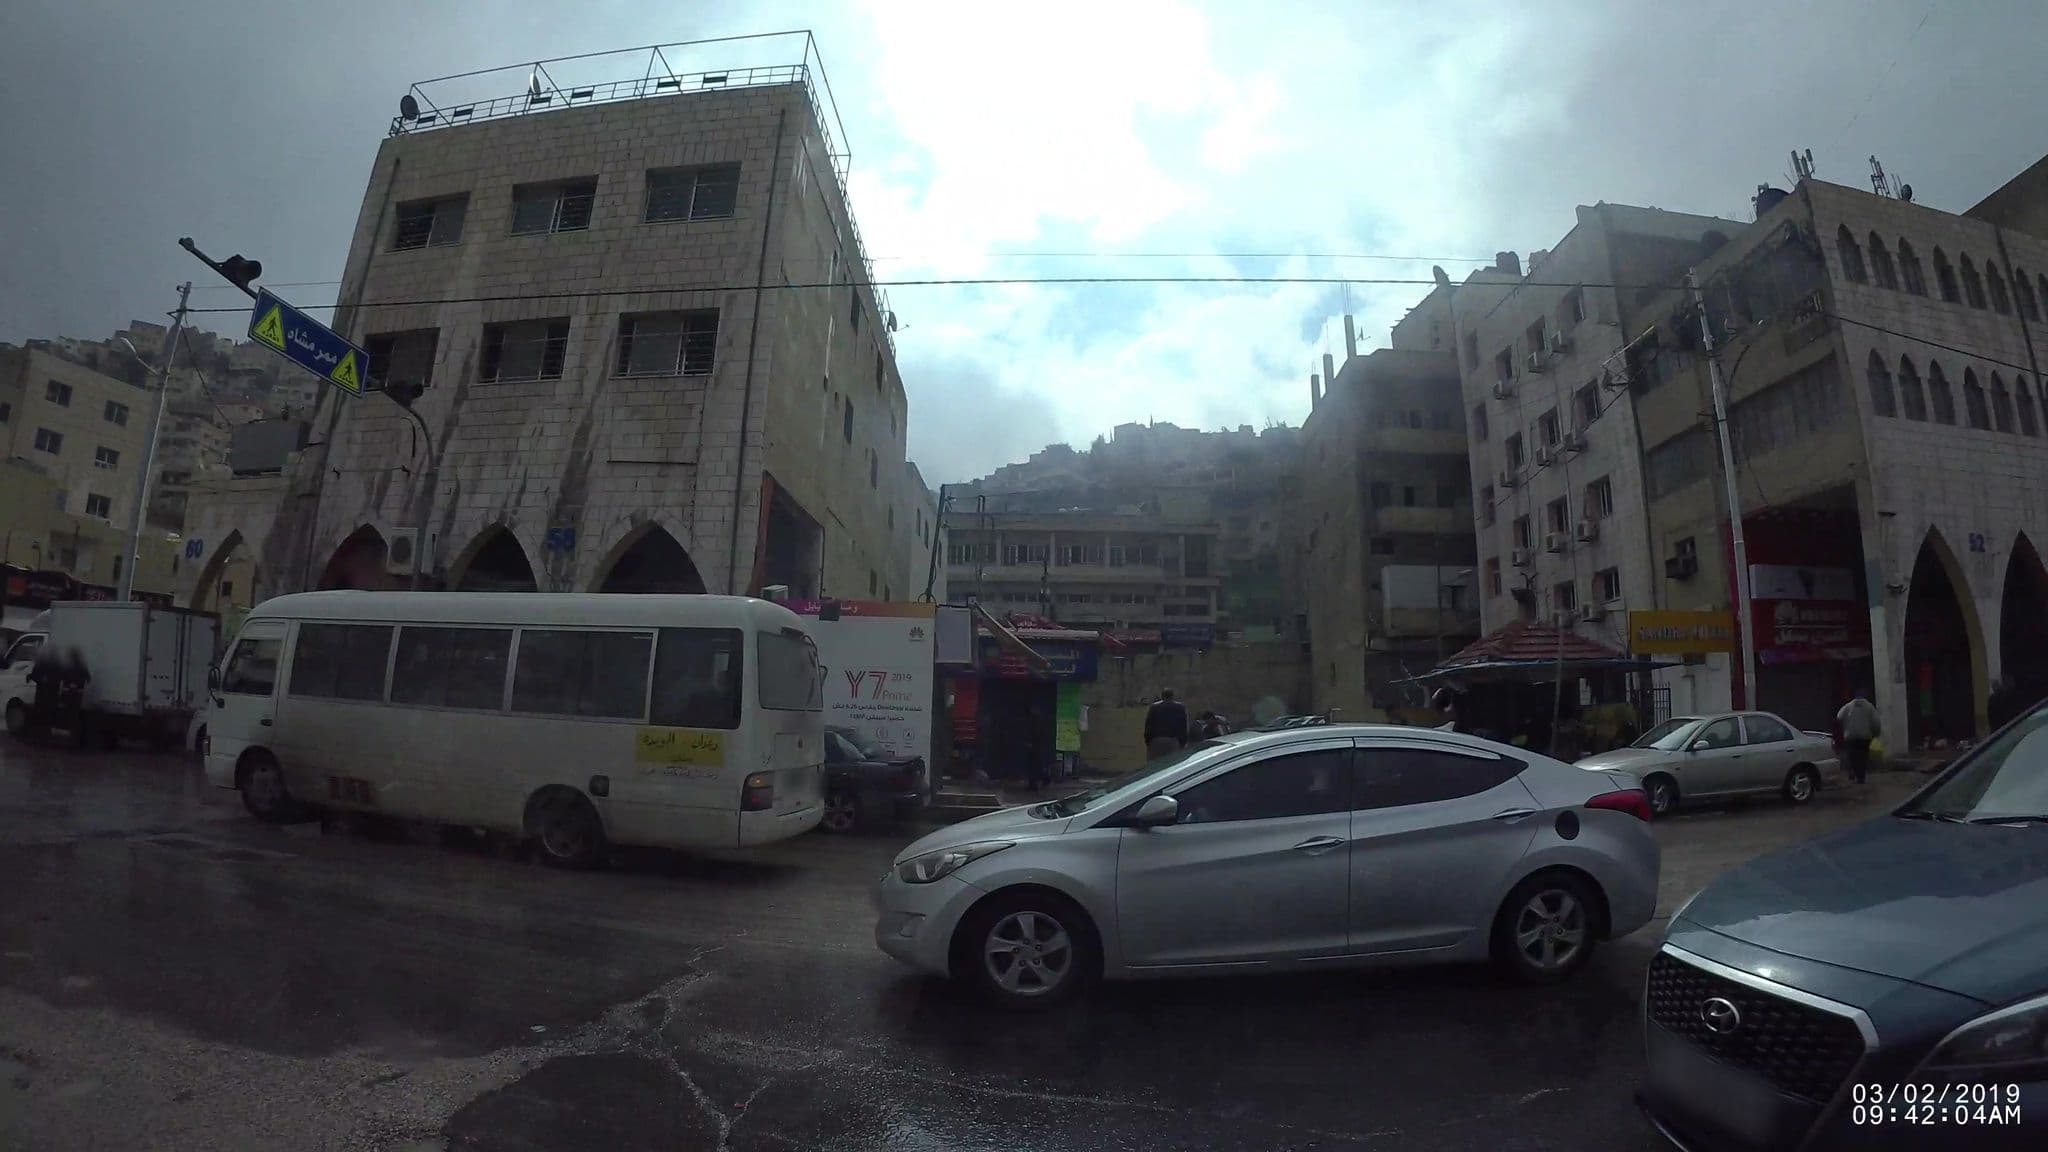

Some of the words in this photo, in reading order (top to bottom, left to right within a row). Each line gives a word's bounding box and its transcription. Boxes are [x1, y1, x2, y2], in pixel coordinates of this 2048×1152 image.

[313, 349, 338, 364] ممر
[844, 670, 887, 699] Y7
[891, 673, 912, 681] 2019
